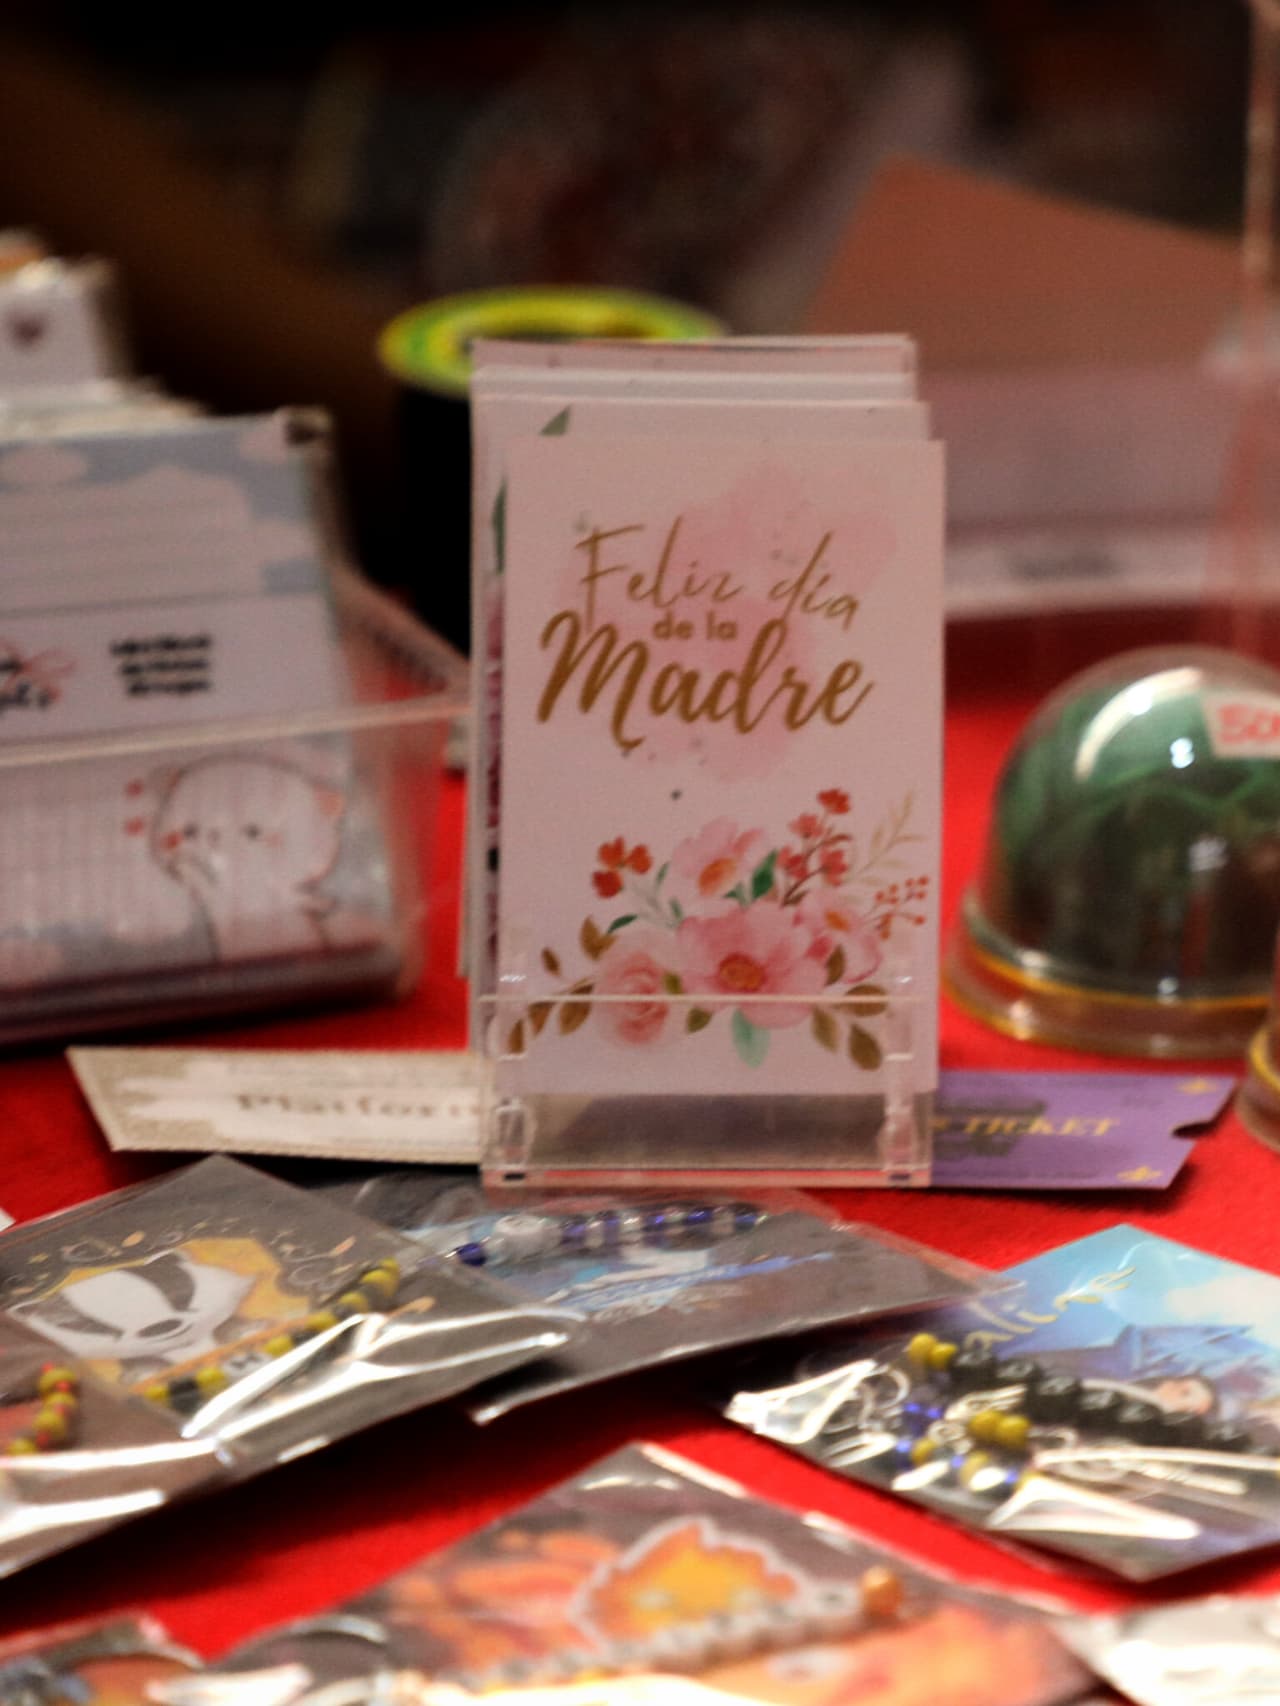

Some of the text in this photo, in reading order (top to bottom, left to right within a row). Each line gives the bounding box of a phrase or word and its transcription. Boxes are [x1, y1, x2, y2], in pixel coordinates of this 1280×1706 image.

[575, 515, 742, 632] Feliz
[653, 612, 738, 639] de la
[536, 609, 875, 749] Madre
